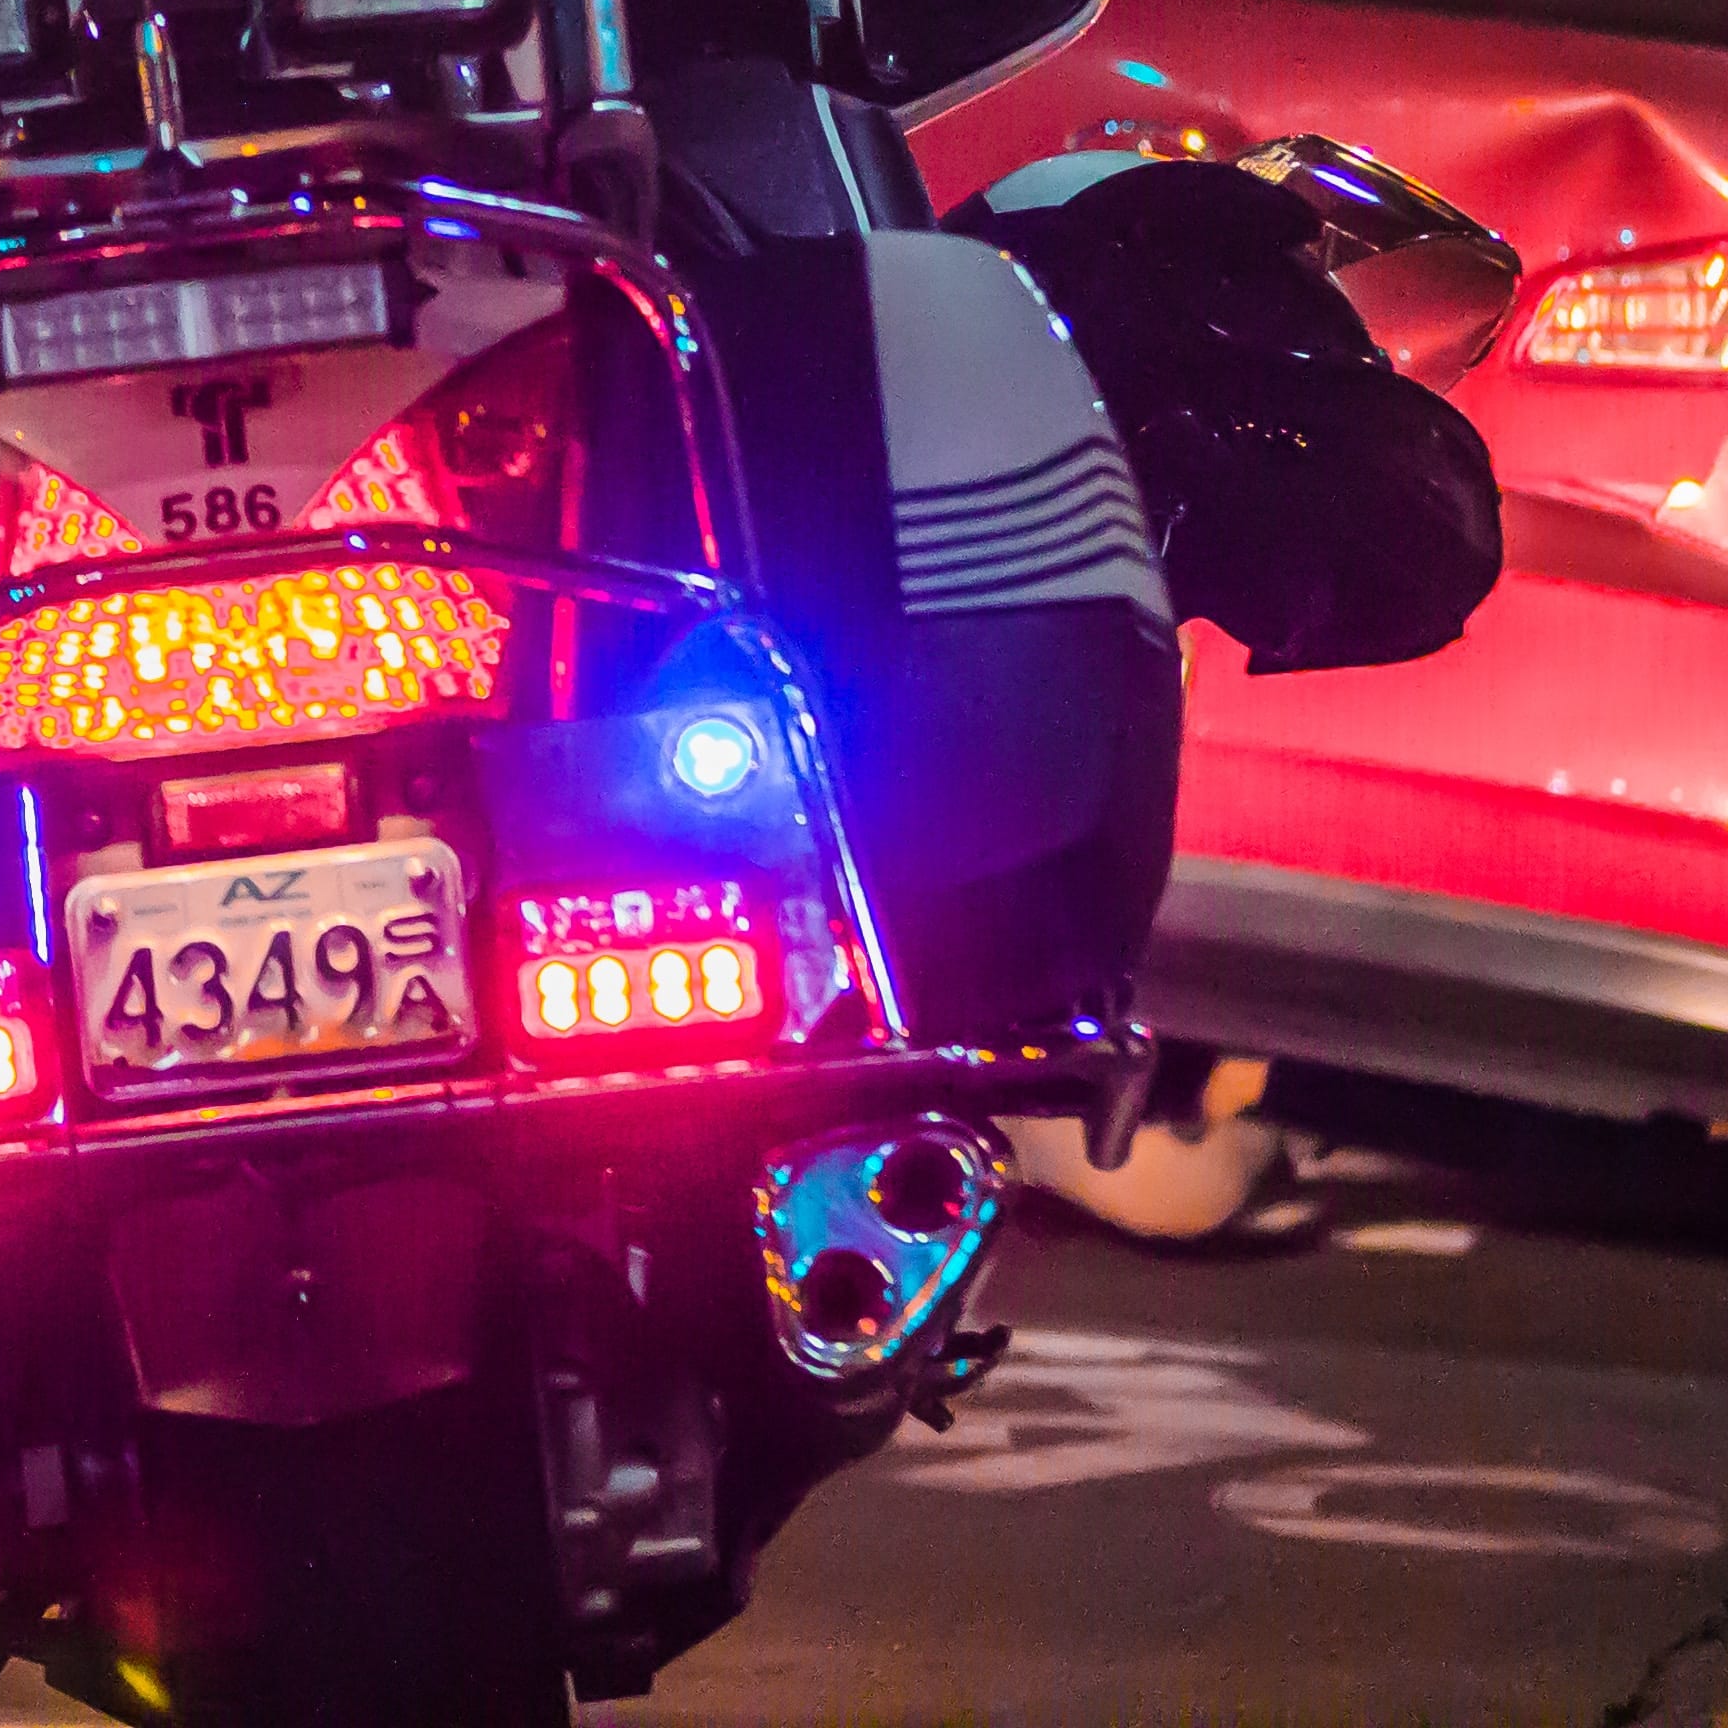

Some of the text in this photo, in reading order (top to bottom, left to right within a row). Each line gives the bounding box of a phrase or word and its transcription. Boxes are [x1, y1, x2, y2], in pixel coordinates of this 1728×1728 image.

[161, 483, 281, 541] 586
[220, 870, 312, 908] AZ
[105, 924, 374, 1048] 4349
